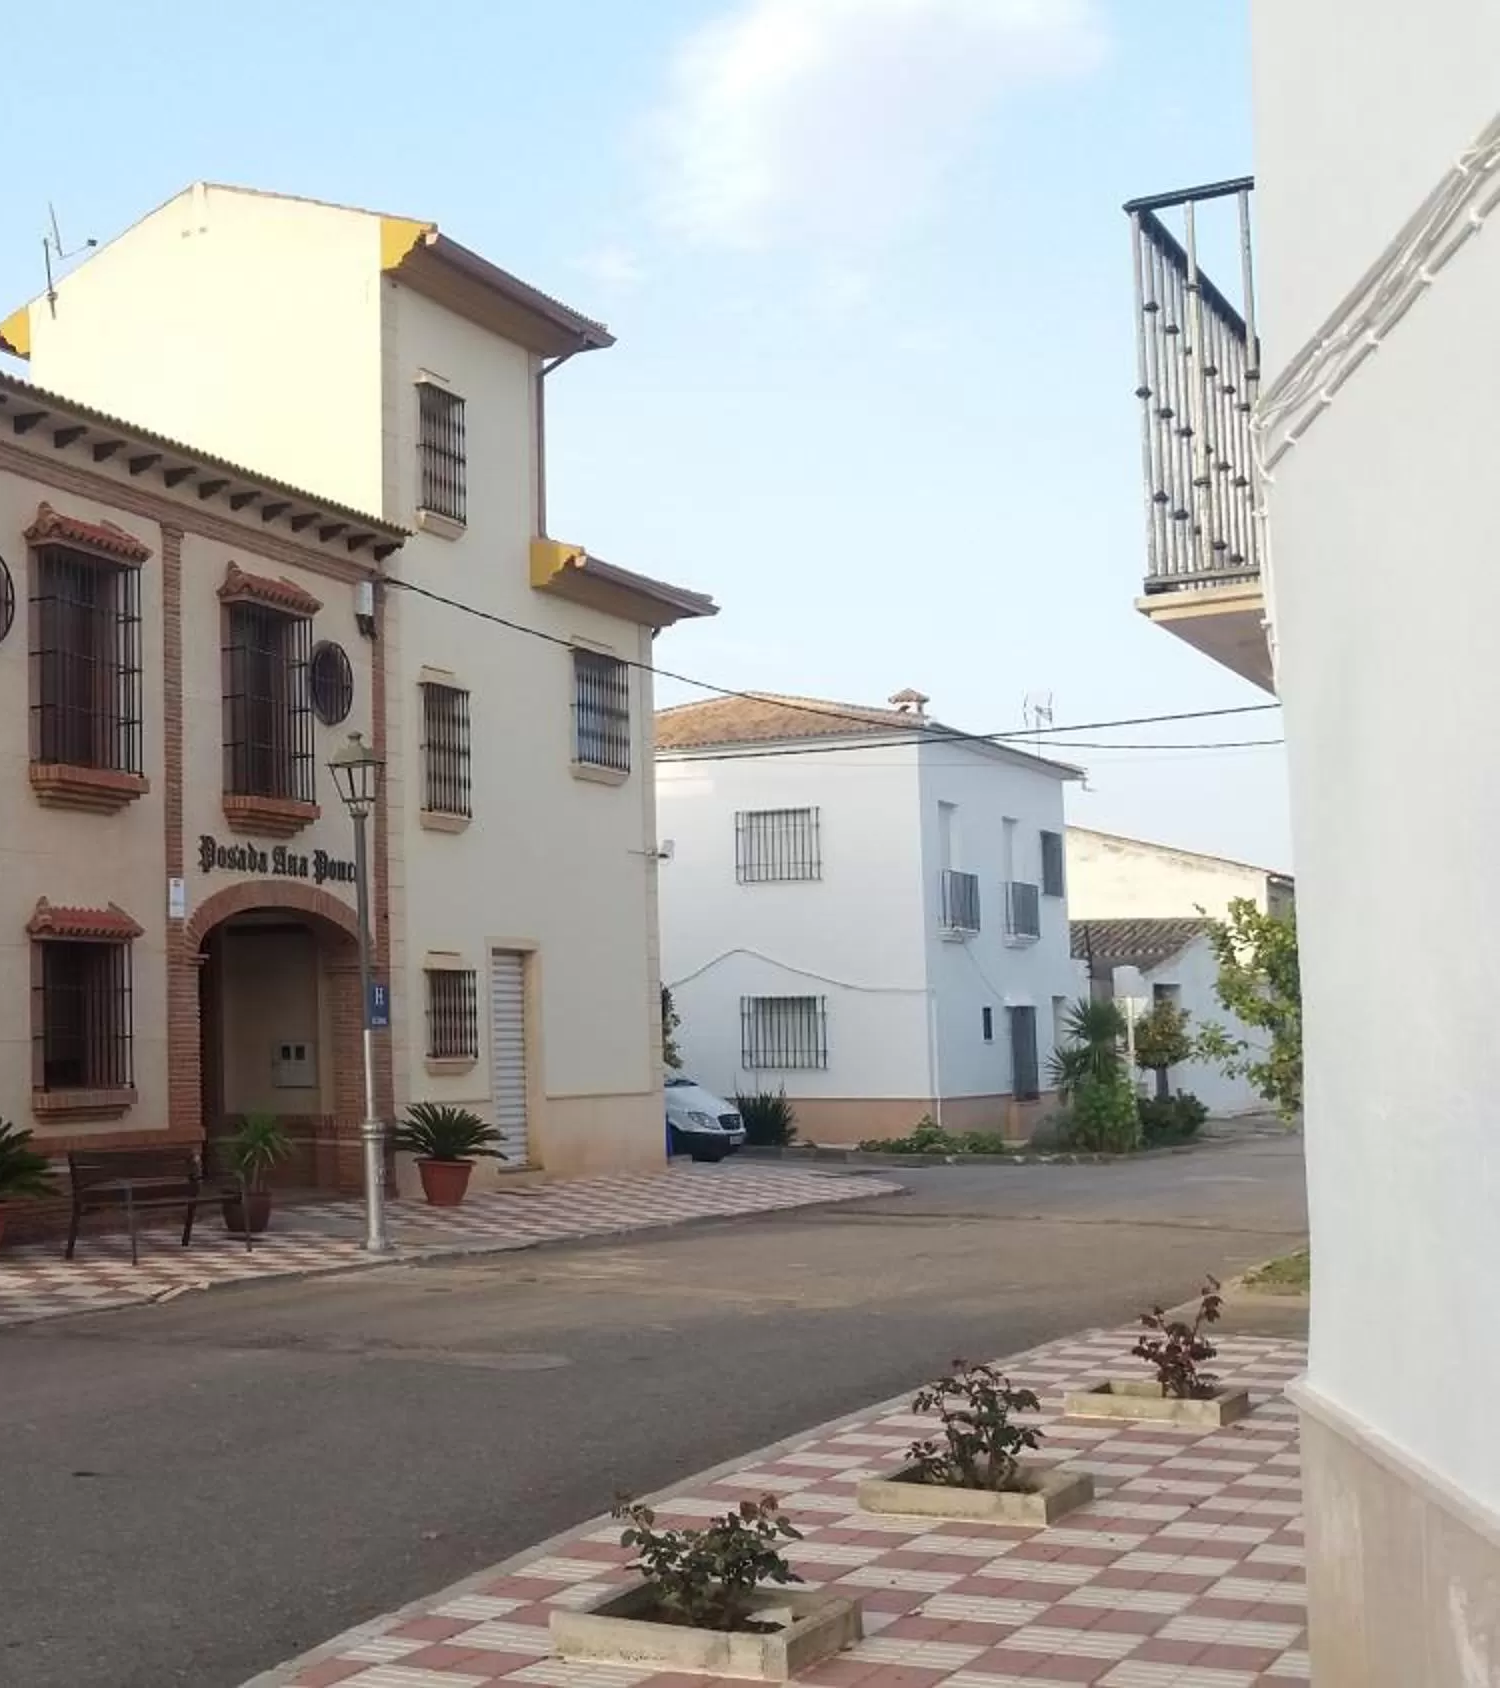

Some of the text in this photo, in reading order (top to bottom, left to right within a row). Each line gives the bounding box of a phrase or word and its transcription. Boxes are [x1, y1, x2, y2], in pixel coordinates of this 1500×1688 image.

[198, 835, 357, 885] Posada Ana Ponc
[375, 987, 385, 1006] H
